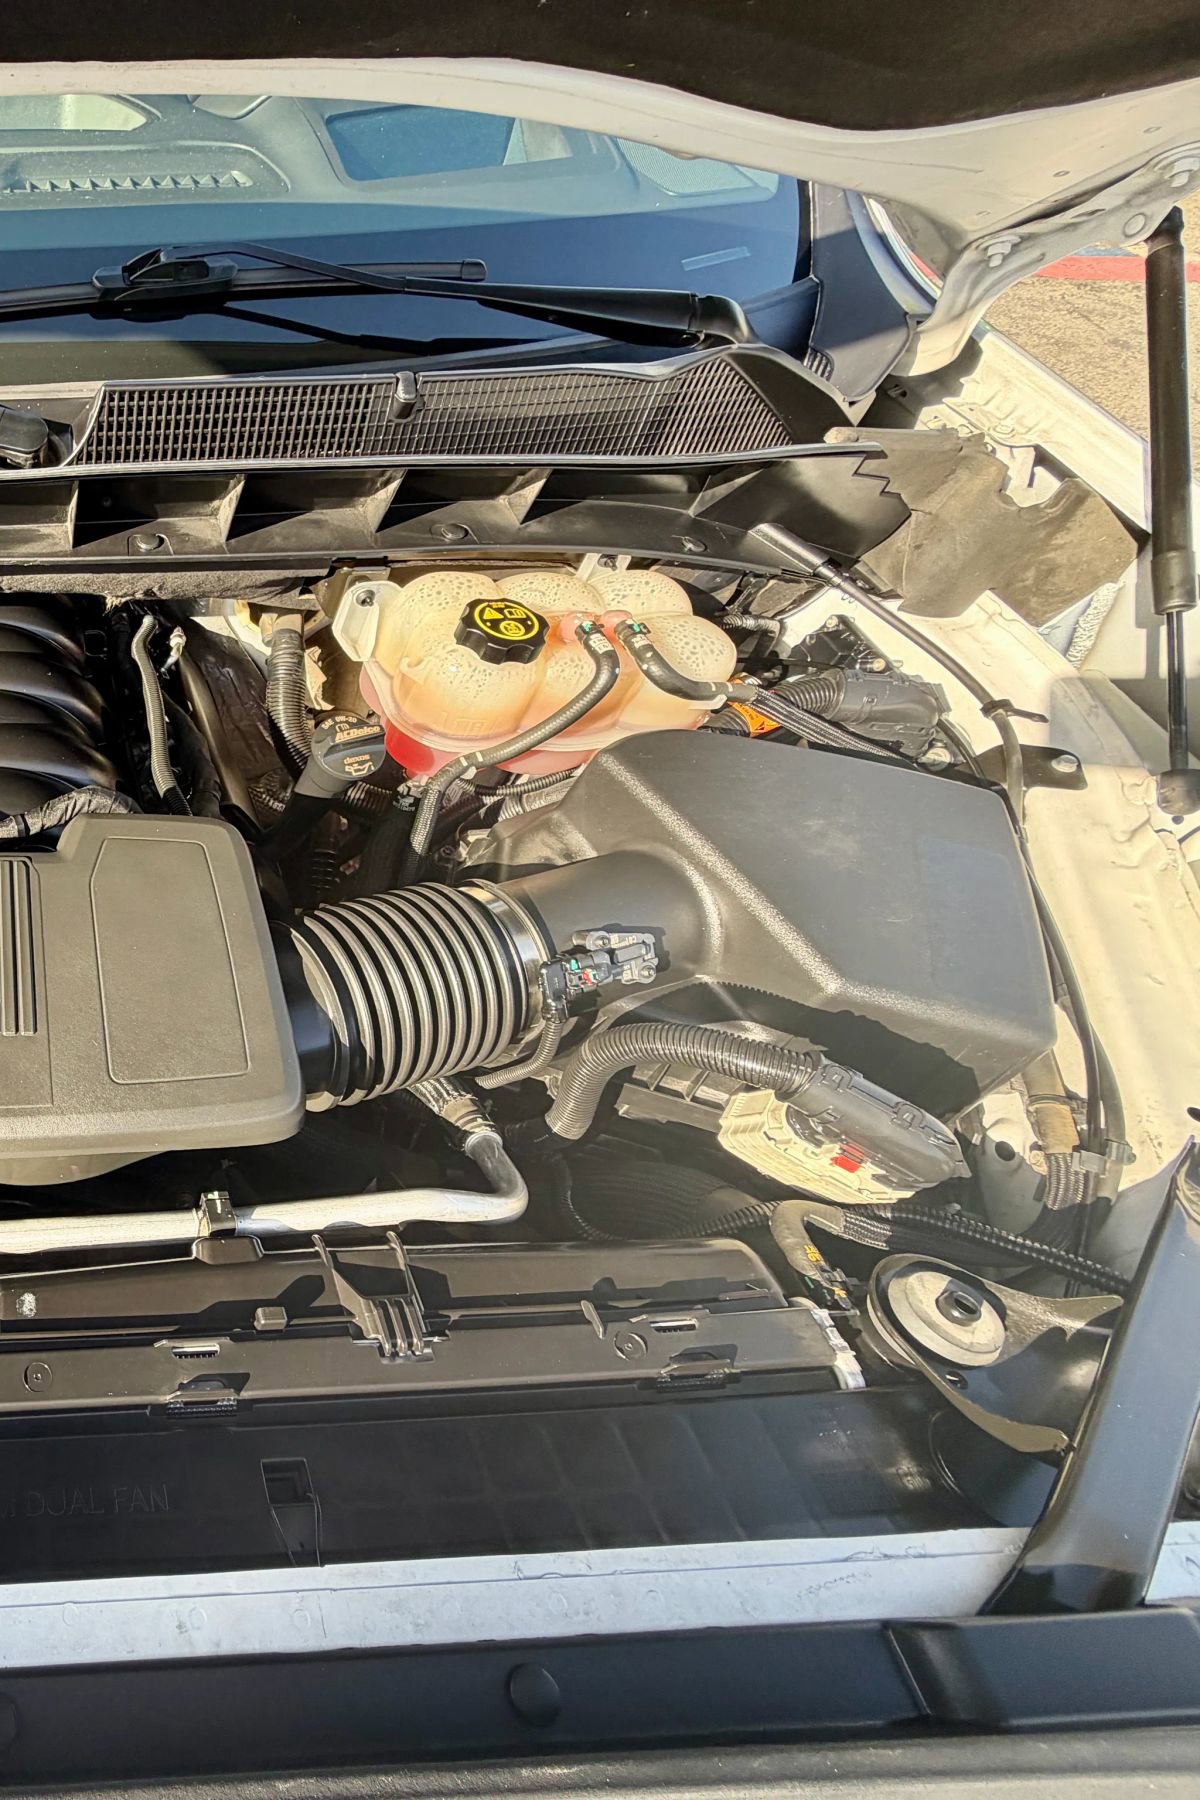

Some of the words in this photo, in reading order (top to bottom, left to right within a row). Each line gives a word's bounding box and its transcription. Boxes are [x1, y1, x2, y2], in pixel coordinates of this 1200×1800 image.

[321, 718, 335, 730] SAE
[335, 715, 358, 723] 0W-20
[335, 726, 381, 743] ACDelco
[343, 754, 370, 765] dexos
[25, 1485, 104, 1518] DUAL
[112, 1482, 170, 1513] FAN
